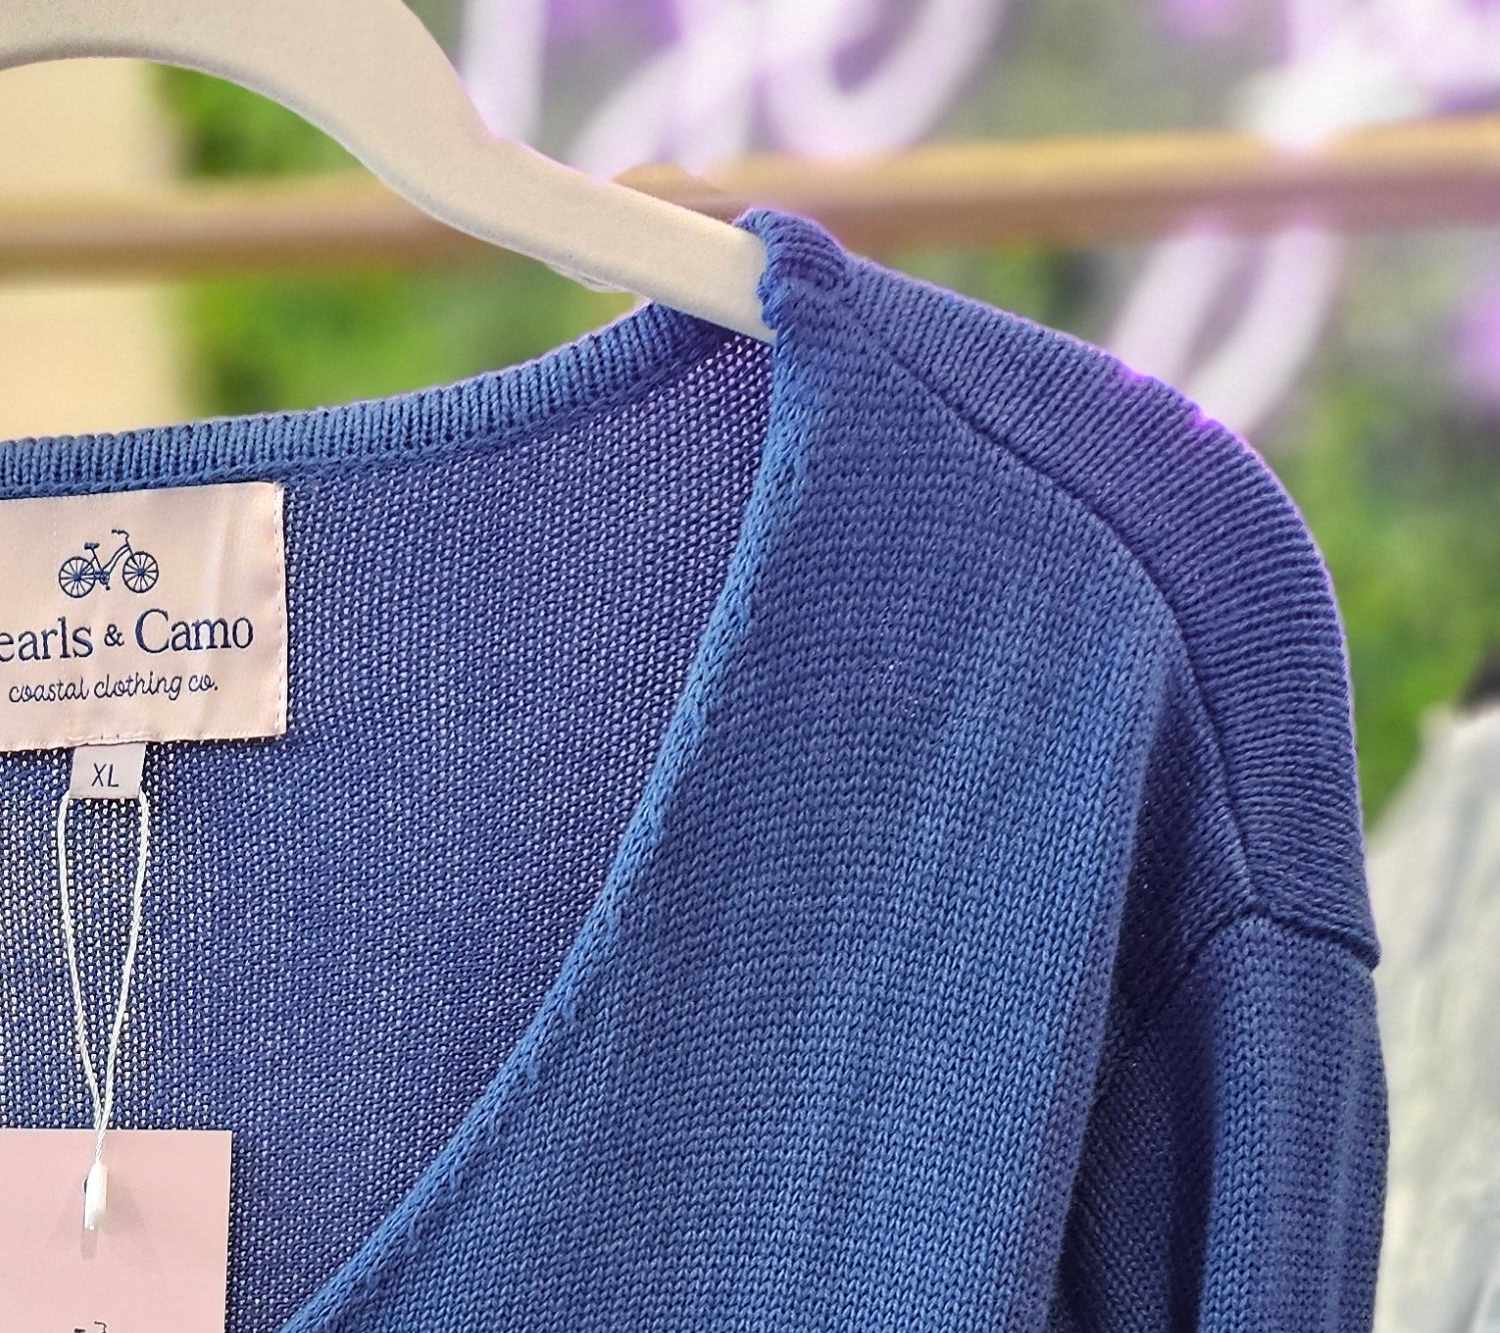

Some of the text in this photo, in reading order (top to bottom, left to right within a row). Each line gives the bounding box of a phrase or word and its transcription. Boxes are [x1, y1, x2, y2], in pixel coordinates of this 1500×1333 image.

[103, 623, 125, 647] &
[134, 608, 254, 654] Camo
[8, 671, 219, 703] coastal clothing co.
[91, 762, 120, 788] XL
